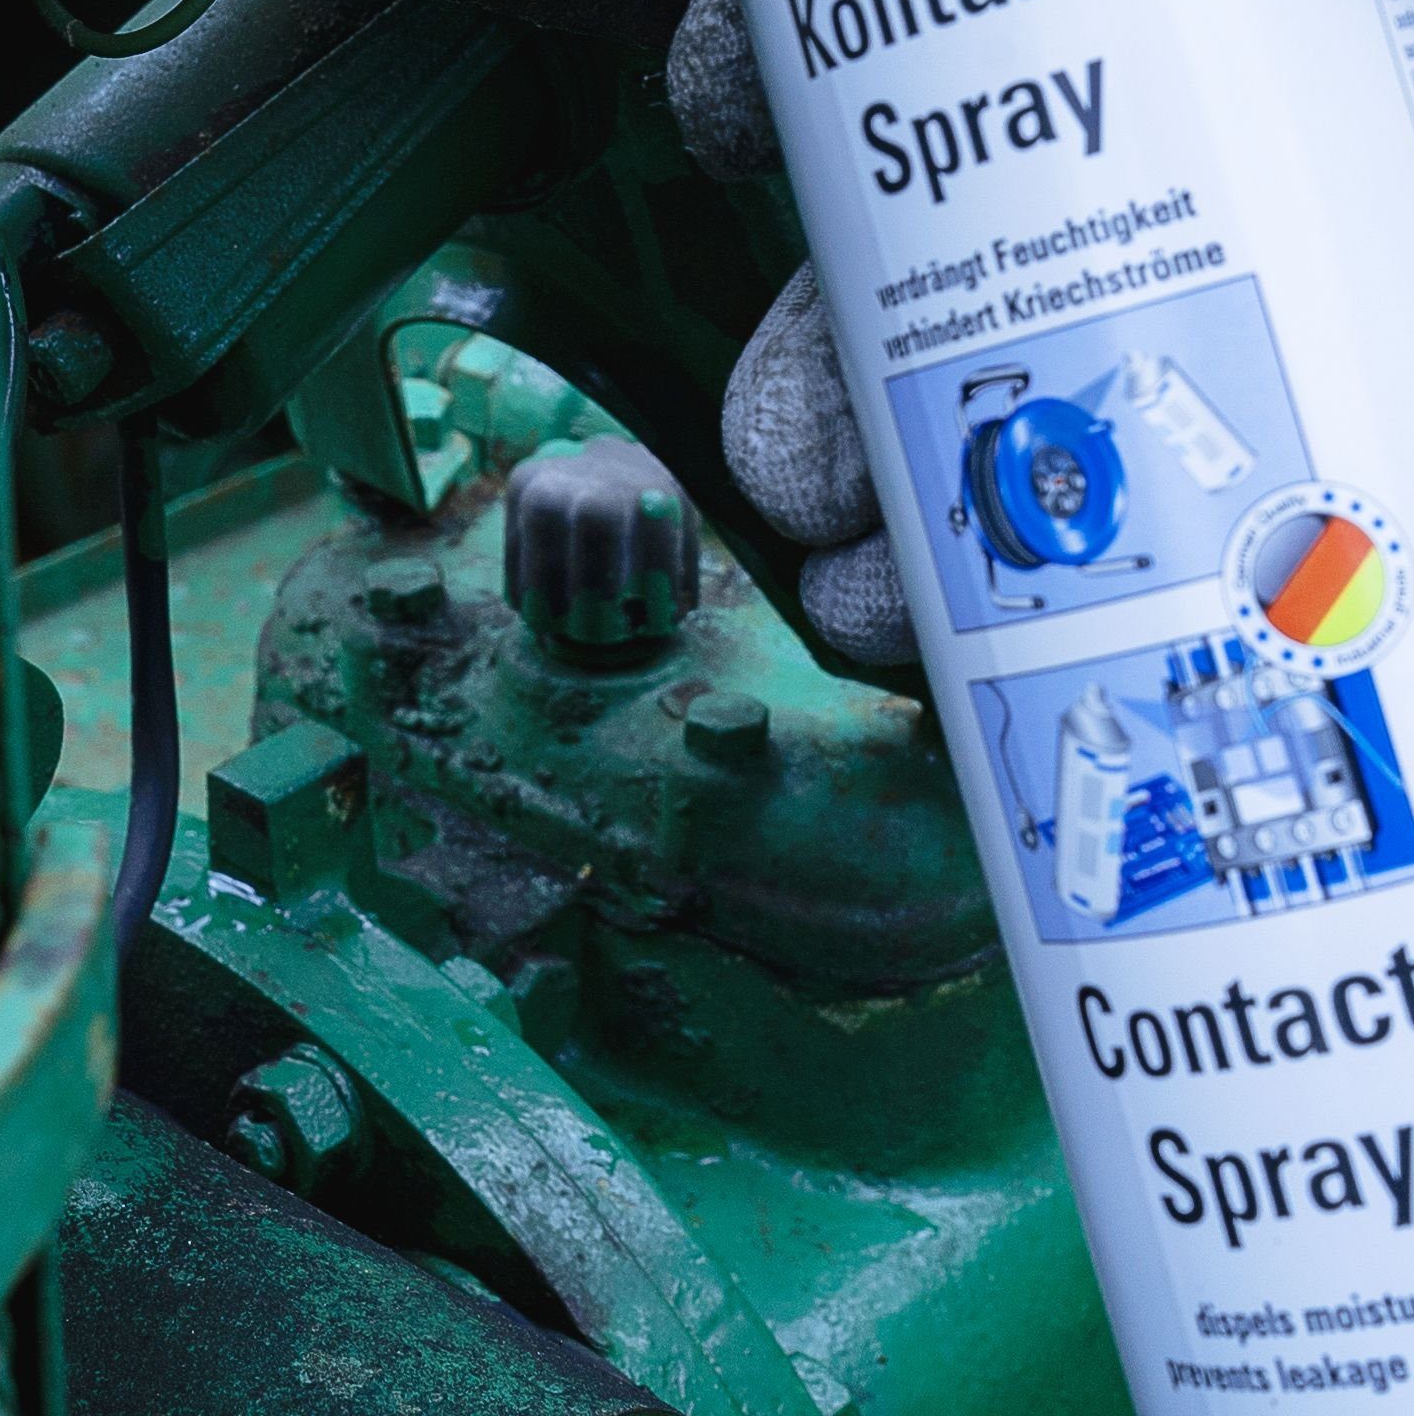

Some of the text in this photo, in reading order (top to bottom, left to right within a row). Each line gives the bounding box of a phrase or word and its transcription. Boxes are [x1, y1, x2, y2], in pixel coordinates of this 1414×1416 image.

[861, 57, 1105, 205] Spray
[875, 187, 1198, 311] verdrängt Feuchtigkeit
[882, 239, 1227, 362] verhindert Kriechströme
[1148, 1124, 1414, 1250] Spray
[1165, 1356, 1273, 1394] prevents
[1273, 1350, 1411, 1396] leakage
[1195, 1299, 1296, 1347] dispels
